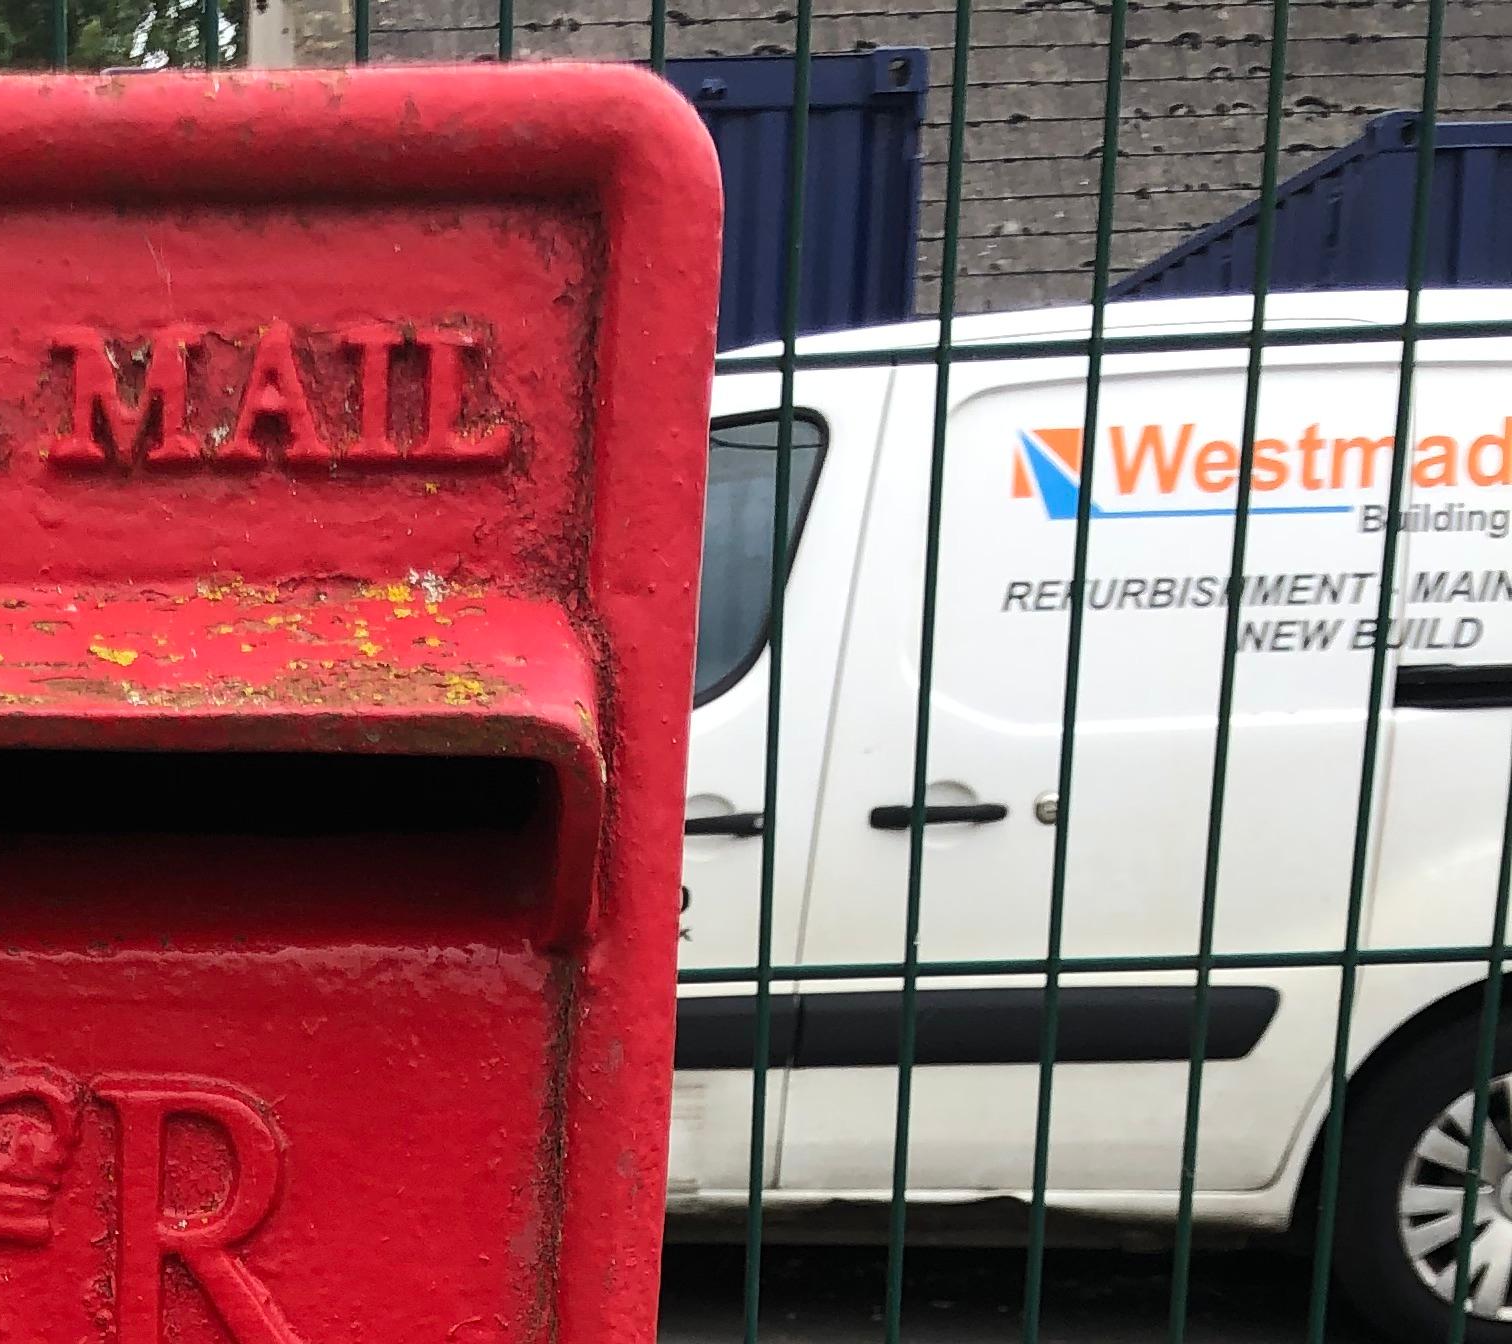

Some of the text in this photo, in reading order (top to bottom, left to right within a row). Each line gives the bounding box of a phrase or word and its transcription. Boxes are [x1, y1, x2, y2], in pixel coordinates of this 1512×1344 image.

[44, 322, 511, 464] MAIL
[1238, 616, 1484, 652] NEW BUILD
